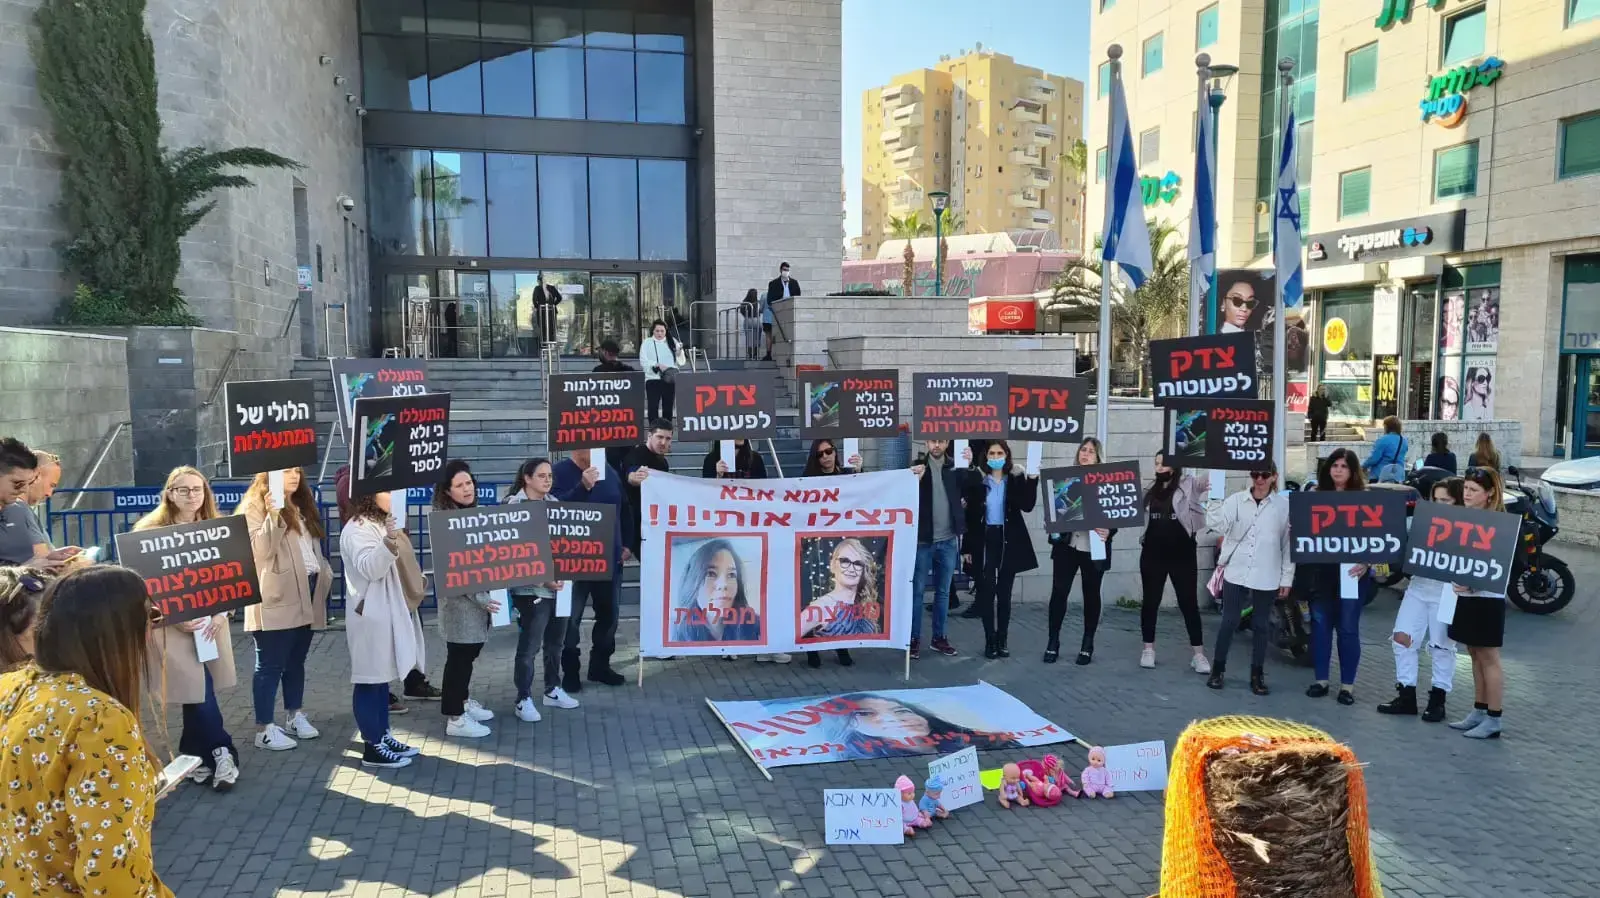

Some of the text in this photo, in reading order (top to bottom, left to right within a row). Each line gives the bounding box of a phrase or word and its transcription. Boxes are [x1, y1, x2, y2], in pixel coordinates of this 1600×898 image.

[1337, 228, 1401, 259] אופטיקלי
[1170, 345, 1236, 378] צדק
[377, 369, 424, 383] התעללו
[843, 378, 894, 392] התעללו
[926, 377, 994, 389] כשהדלתות
[1158, 372, 1252, 397] לפעוטות
[563, 378, 631, 393] כשהדלתות
[576, 394, 620, 406] נסגרות
[695, 384, 756, 414] צדק
[855, 391, 894, 403] בי ולא
[939, 391, 983, 402] נסגרות
[1009, 385, 1069, 414] צדק
[236, 400, 310, 426] הלולי של
[399, 407, 445, 425] התעללו
[560, 407, 634, 425] המפלצות
[855, 404, 894, 416] יכולתי
[923, 402, 998, 418] המפלצות
[1211, 408, 1269, 422] התעללו
[682, 411, 771, 432] לפעוטות
[859, 415, 893, 428] לספר
[920, 418, 1002, 434] מתעוררות
[1008, 416, 1080, 434] לפעוטו
[1224, 421, 1268, 434] בי ולא
[233, 428, 315, 454] המתעללות
[409, 424, 444, 440] בי ולא
[556, 425, 638, 444] מתעוררות
[408, 440, 444, 457] יכולתי
[1223, 435, 1267, 448] יכולתי
[1226, 447, 1266, 461] לספר
[411, 457, 442, 473] לספר
[1084, 470, 1136, 484] התעללו
[720, 485, 839, 503] אמא אבא
[1098, 483, 1136, 495] בי ולא
[116, 494, 161, 506] משפט
[1098, 495, 1138, 506] יכולתי
[448, 509, 531, 531] כשהדלתות
[547, 506, 602, 522] כשהדלתו
[650, 504, 914, 527] תצילו אותי!!!
[1103, 507, 1138, 519] לספר
[1311, 504, 1383, 534] צדק
[140, 526, 231, 554] כשהדלתות
[466, 527, 520, 545] נסגרות
[1426, 516, 1496, 550] צדק
[551, 537, 604, 556] המפלצ
[1296, 533, 1400, 554] לפעוטות
[161, 546, 221, 570] נסגרות
[448, 542, 540, 568] המפלצות
[1409, 546, 1504, 581] לפעוטות
[554, 557, 608, 573] מתעור
[144, 561, 243, 596] המפלצות
[445, 561, 546, 589] מתעוררות
[156, 581, 253, 616] מתעוררו
[674, 602, 756, 625] מפלצת
[806, 600, 880, 623] מפלצת
[1132, 765, 1149, 782] לא
[826, 791, 898, 808] אמא אבא
[834, 828, 861, 840] אותי
